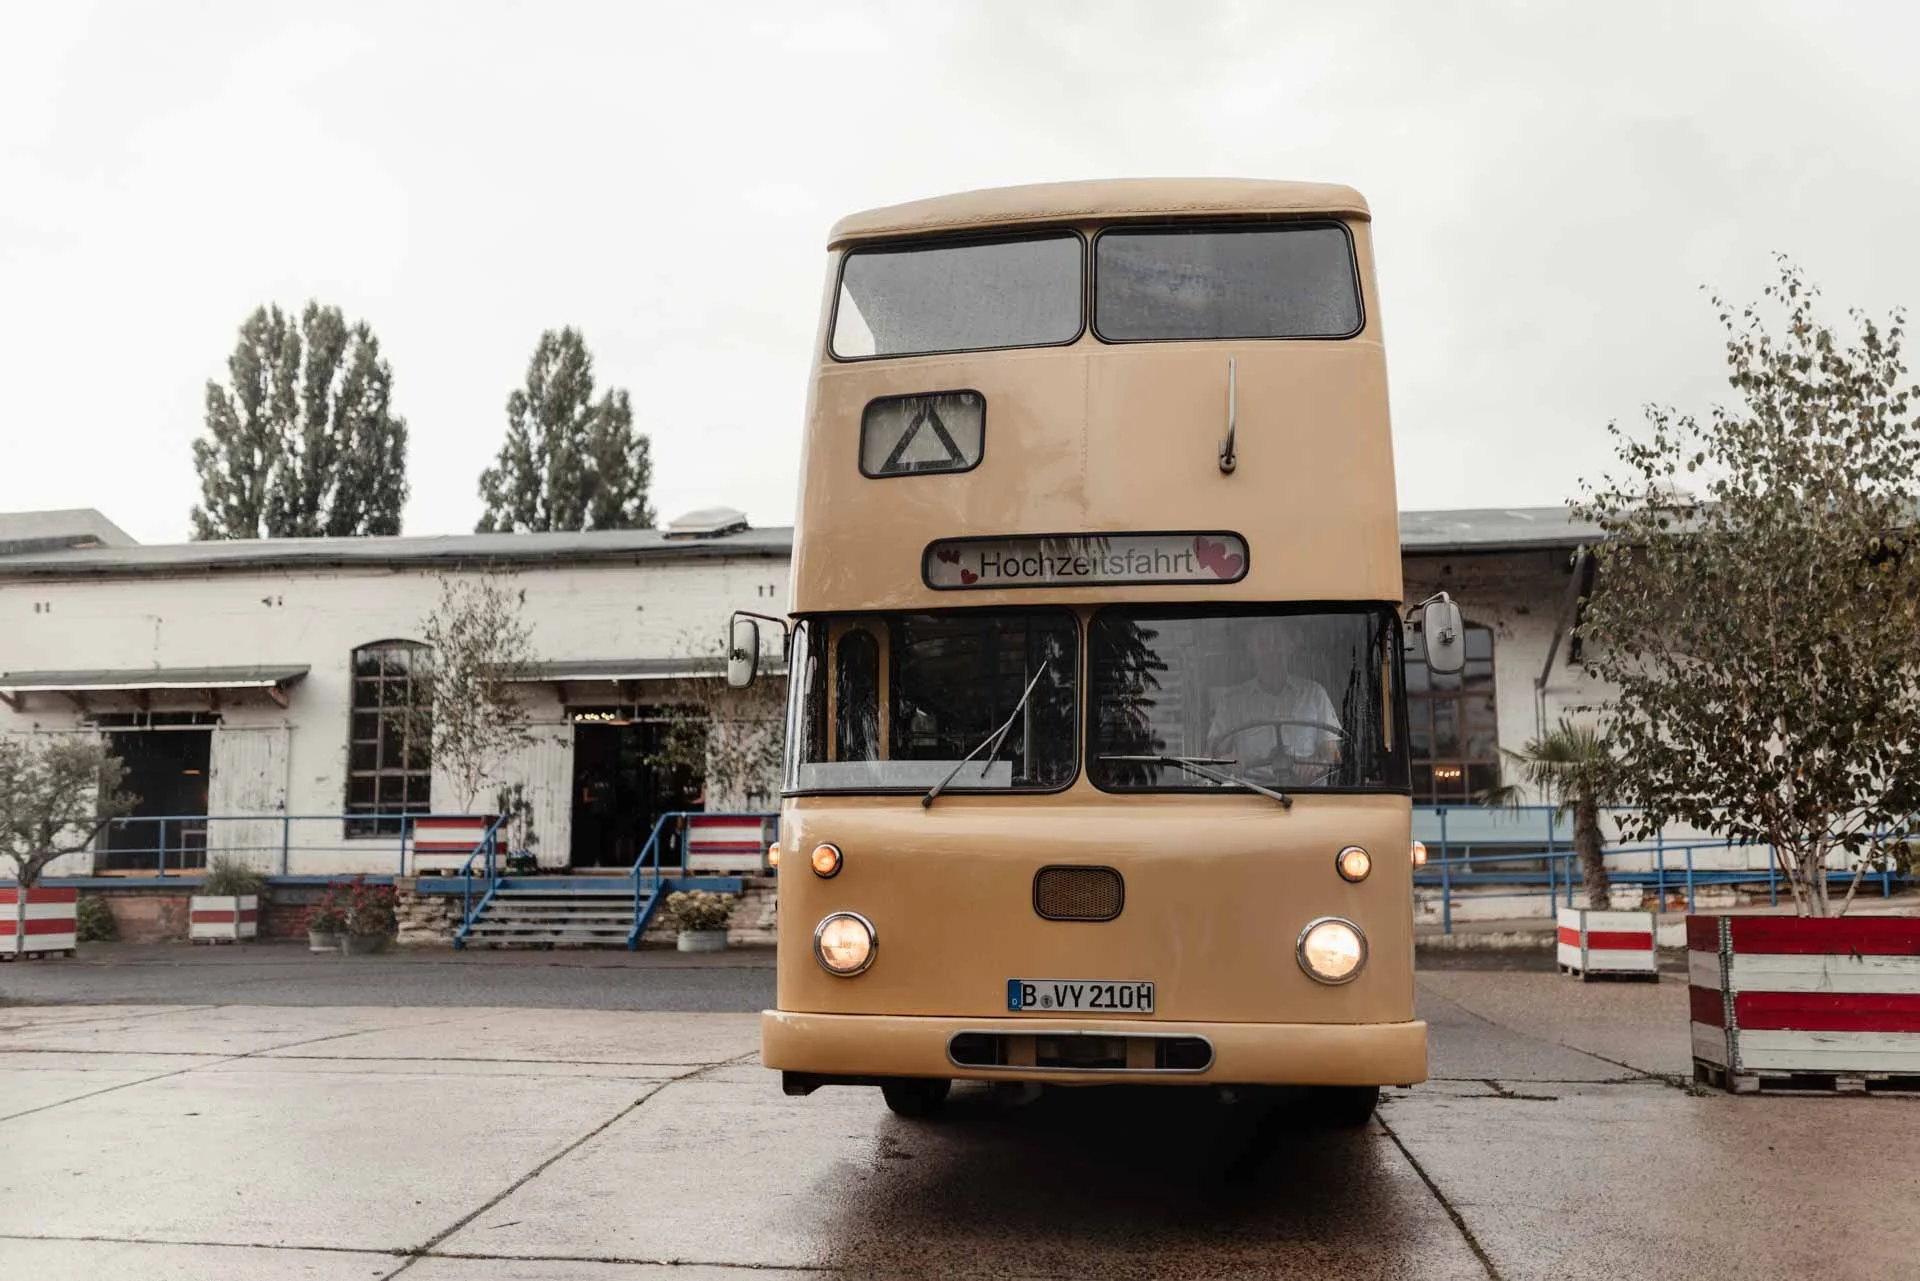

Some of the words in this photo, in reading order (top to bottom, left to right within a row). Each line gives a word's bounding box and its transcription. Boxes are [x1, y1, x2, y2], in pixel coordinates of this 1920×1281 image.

[981, 549, 1193, 577] Hochzeitsfahrt
[1011, 998, 1018, 1006] D
[1022, 984, 1037, 1007] B
[1054, 985, 1084, 1008] VY
[1089, 986, 1152, 1009] 210H
